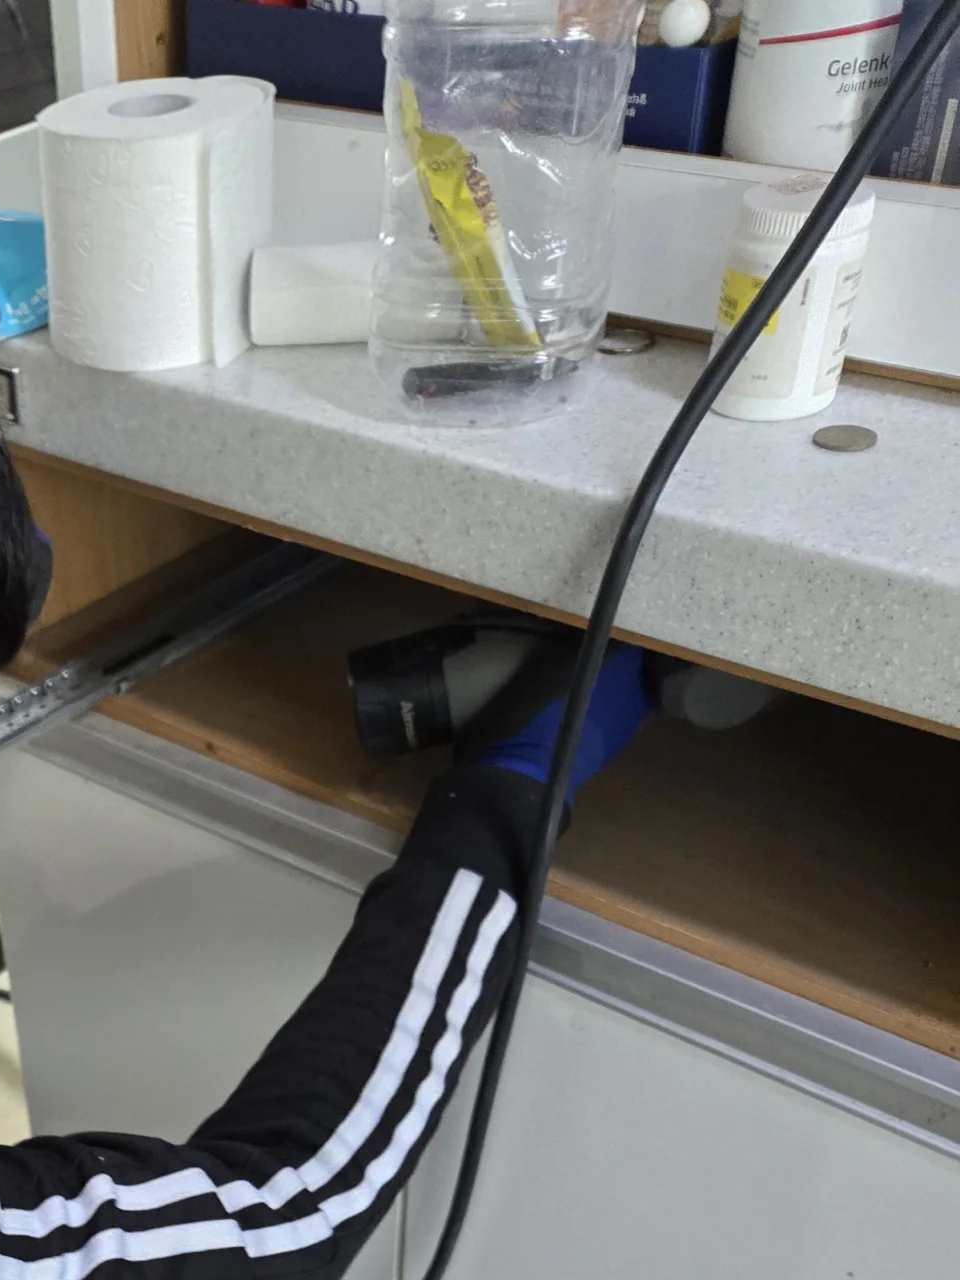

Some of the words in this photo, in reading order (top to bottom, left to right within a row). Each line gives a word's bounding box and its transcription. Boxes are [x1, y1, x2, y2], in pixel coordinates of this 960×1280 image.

[827, 53, 890, 77] Gelenk
[836, 79, 867, 94] Joint
[868, 76, 892, 90] Hea
